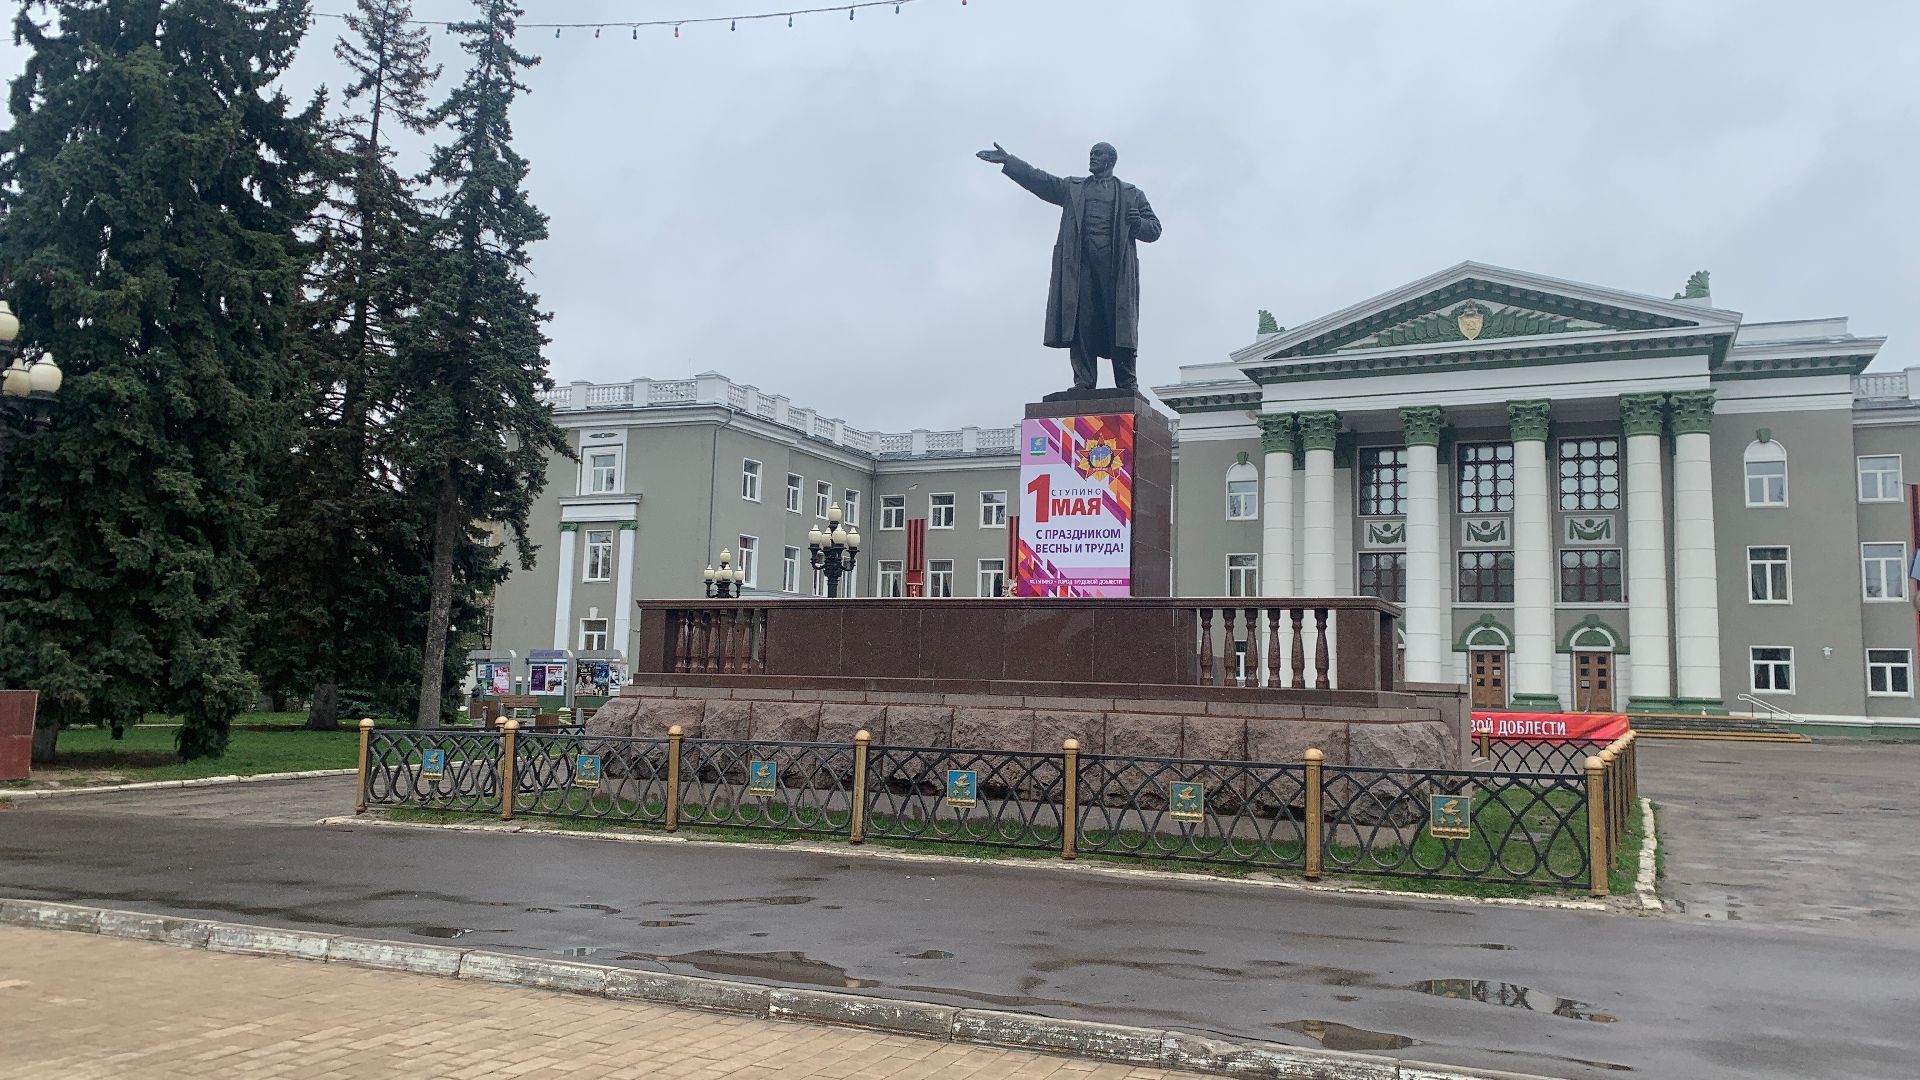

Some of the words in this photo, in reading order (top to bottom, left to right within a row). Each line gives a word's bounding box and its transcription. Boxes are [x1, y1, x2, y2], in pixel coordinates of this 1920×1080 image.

[1027, 474, 1051, 523] 1
[1051, 497, 1102, 516] МАЯ
[1051, 488, 1101, 497] СТУПИНО
[1035, 529, 1043, 540] С
[1044, 528, 1121, 541] ПРАЗДНИКОМ
[1035, 543, 1072, 554] ВЕСНЫ
[1074, 543, 1082, 553] И
[1084, 542, 1124, 555] ТРУДА!
[1498, 720, 1566, 736] ДОБЛЕСТИ
